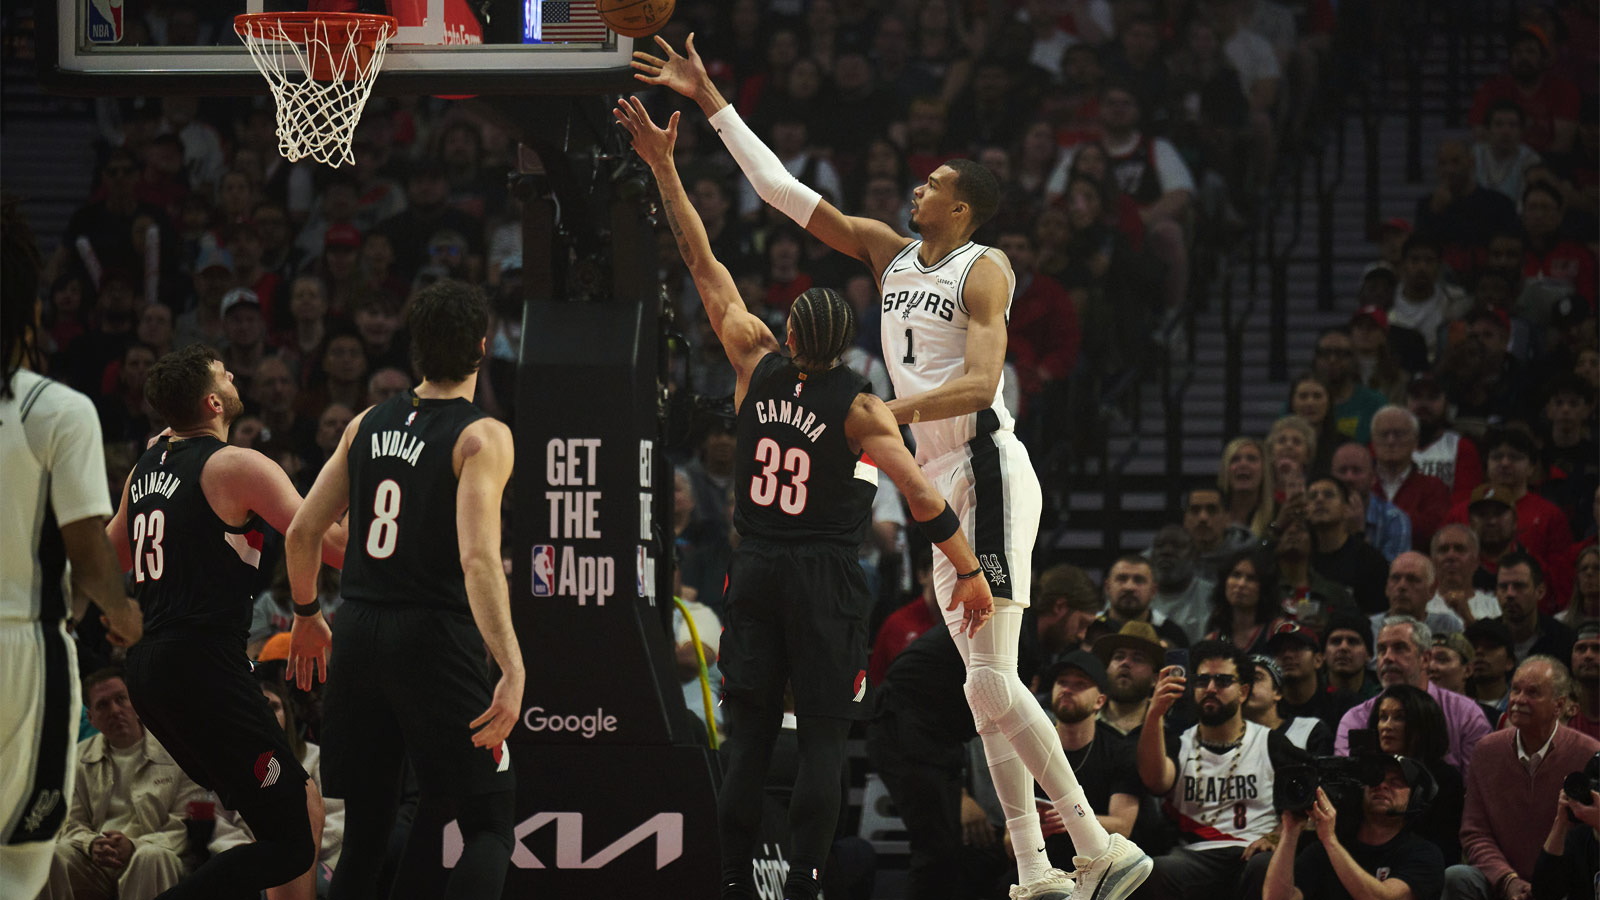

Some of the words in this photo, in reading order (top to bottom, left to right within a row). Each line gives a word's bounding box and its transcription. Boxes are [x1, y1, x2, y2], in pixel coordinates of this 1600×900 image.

[92, 24, 110, 38] NBA
[883, 291, 955, 322] SPURS
[902, 328, 917, 365] 1
[755, 399, 827, 443] CAMARA
[371, 430, 426, 468] AVDIJA
[546, 438, 602, 486] GET
[130, 471, 181, 504] CLINGAN
[750, 437, 811, 516] 33
[366, 478, 402, 560] 8
[545, 491, 602, 539] THE
[133, 508, 165, 584] 23
[557, 545, 615, 606] App
[523, 706, 618, 739] Google
[1233, 803, 1247, 830] 8
